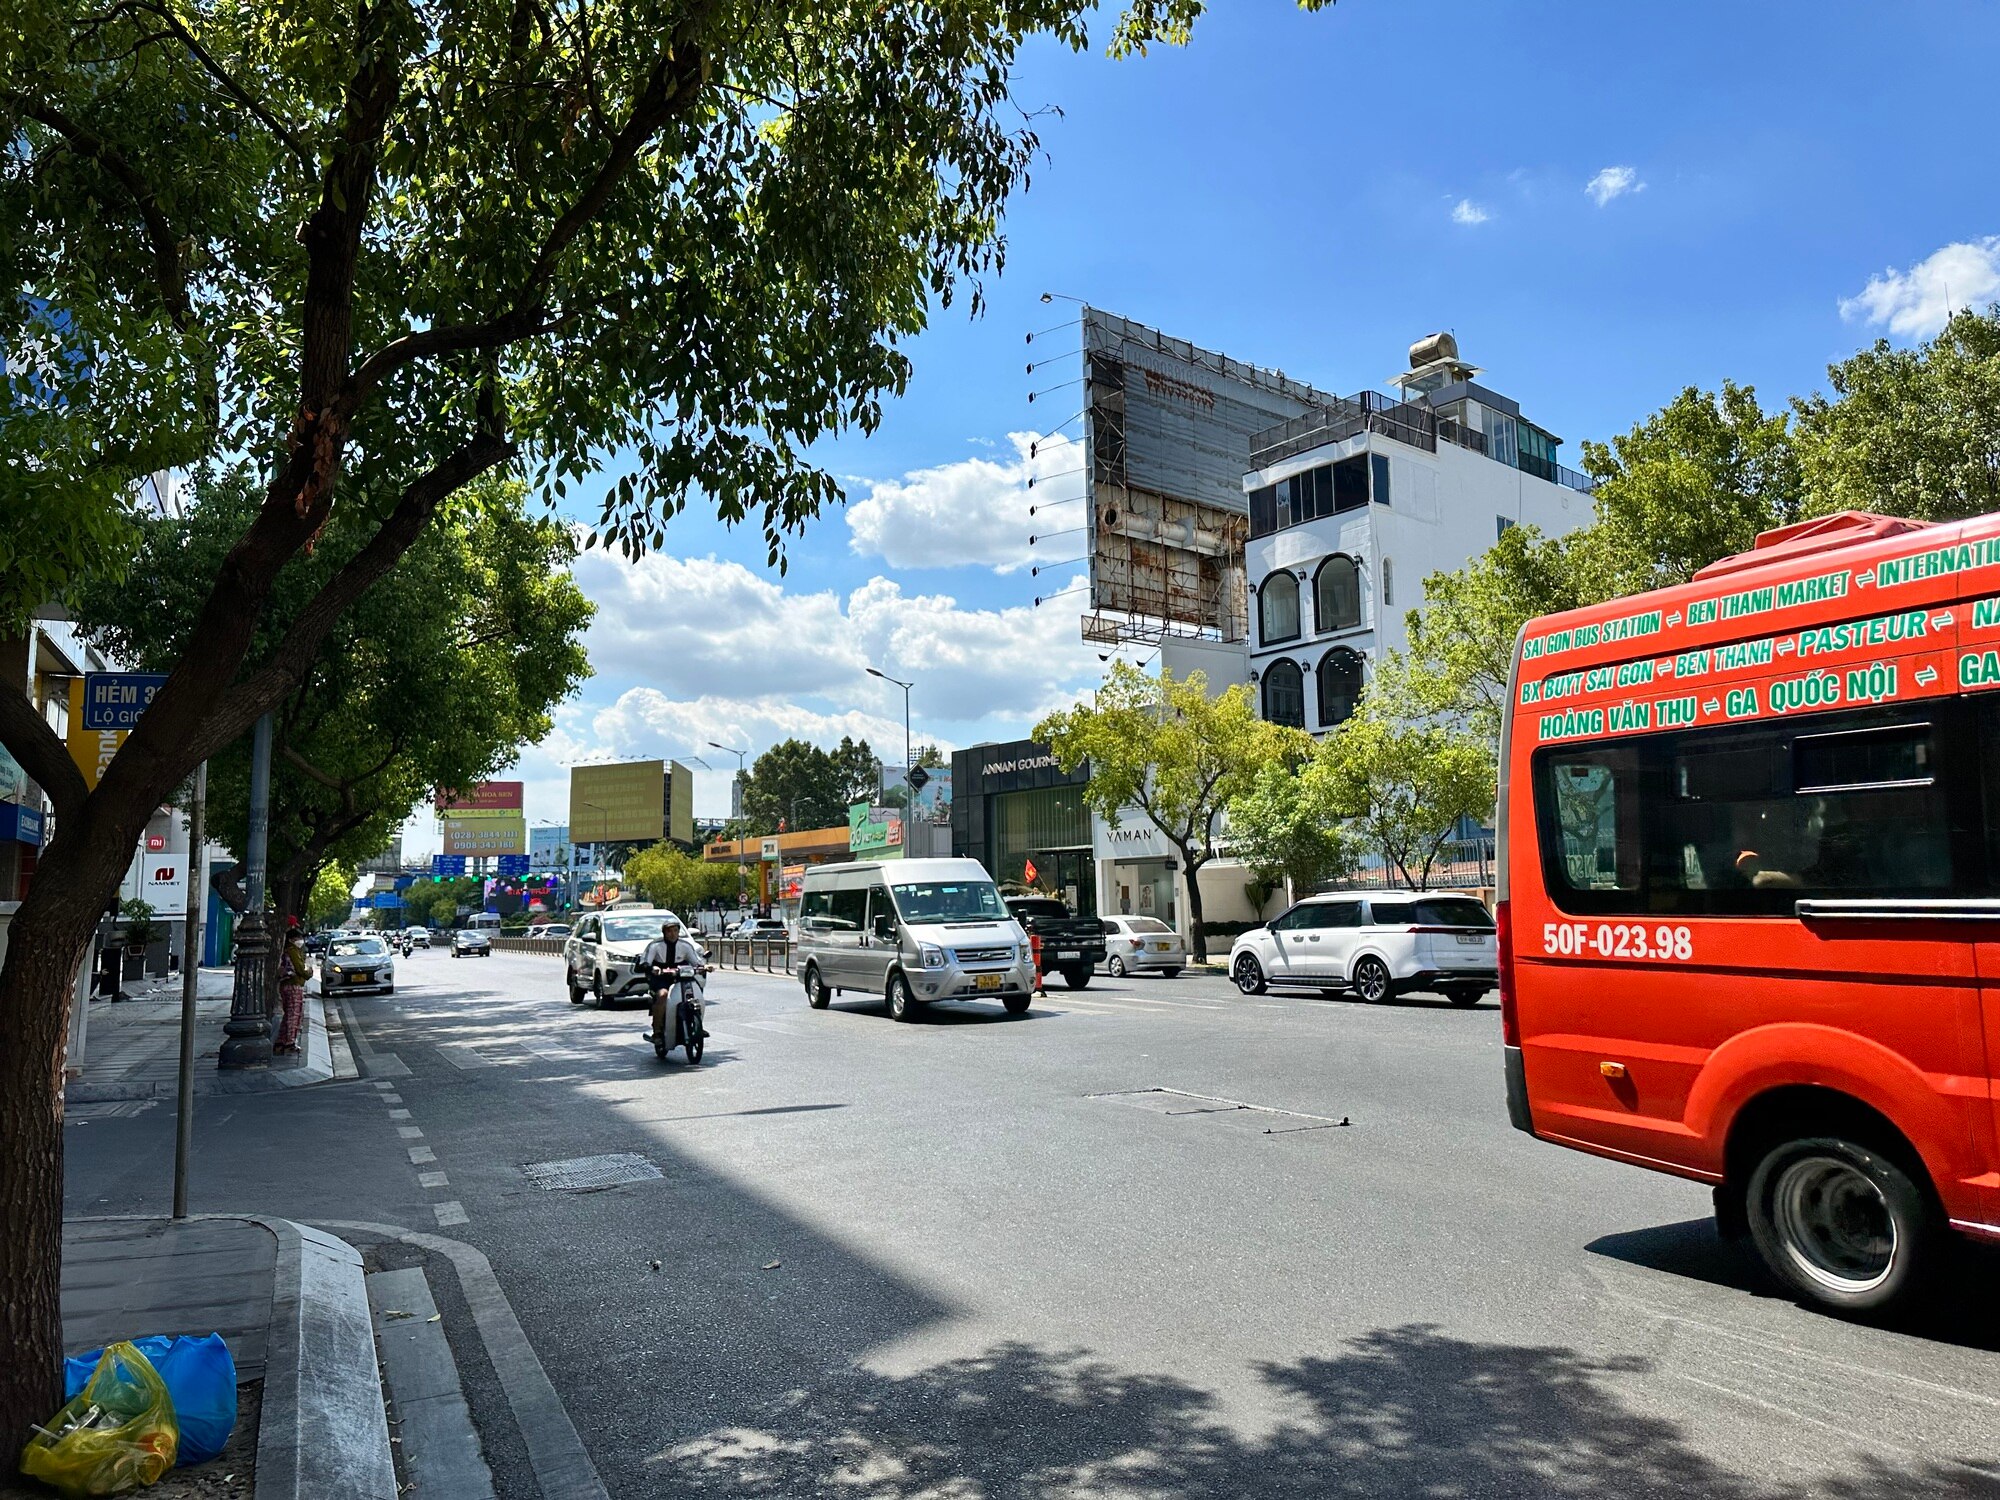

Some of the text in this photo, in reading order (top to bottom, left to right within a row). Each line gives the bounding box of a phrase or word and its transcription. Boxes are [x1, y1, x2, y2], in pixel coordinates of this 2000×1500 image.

[1523, 638, 1545, 659] SAI
[1547, 630, 1572, 654] GON
[1574, 625, 1599, 648] BUS
[1602, 611, 1662, 643] STATION
[1687, 599, 1718, 626] BEN
[1720, 586, 1774, 620] THANH
[1776, 570, 1851, 609] MARKET
[1521, 680, 1542, 704] BX
[1797, 611, 1927, 657] PASTEUR
[95, 679, 162, 705] HẺM 3
[1538, 709, 1603, 741] HOÀNG
[1608, 702, 1651, 731] VĂN
[1726, 687, 1759, 718] GA
[1769, 669, 1840, 713] QUỐC
[1846, 662, 1898, 703] NỘI
[94, 707, 114, 725] LỘ
[982, 760, 1017, 776] ANNAM
[1106, 828, 1151, 843] YAMAN
[1543, 923, 1693, 960] 50F-023.98
